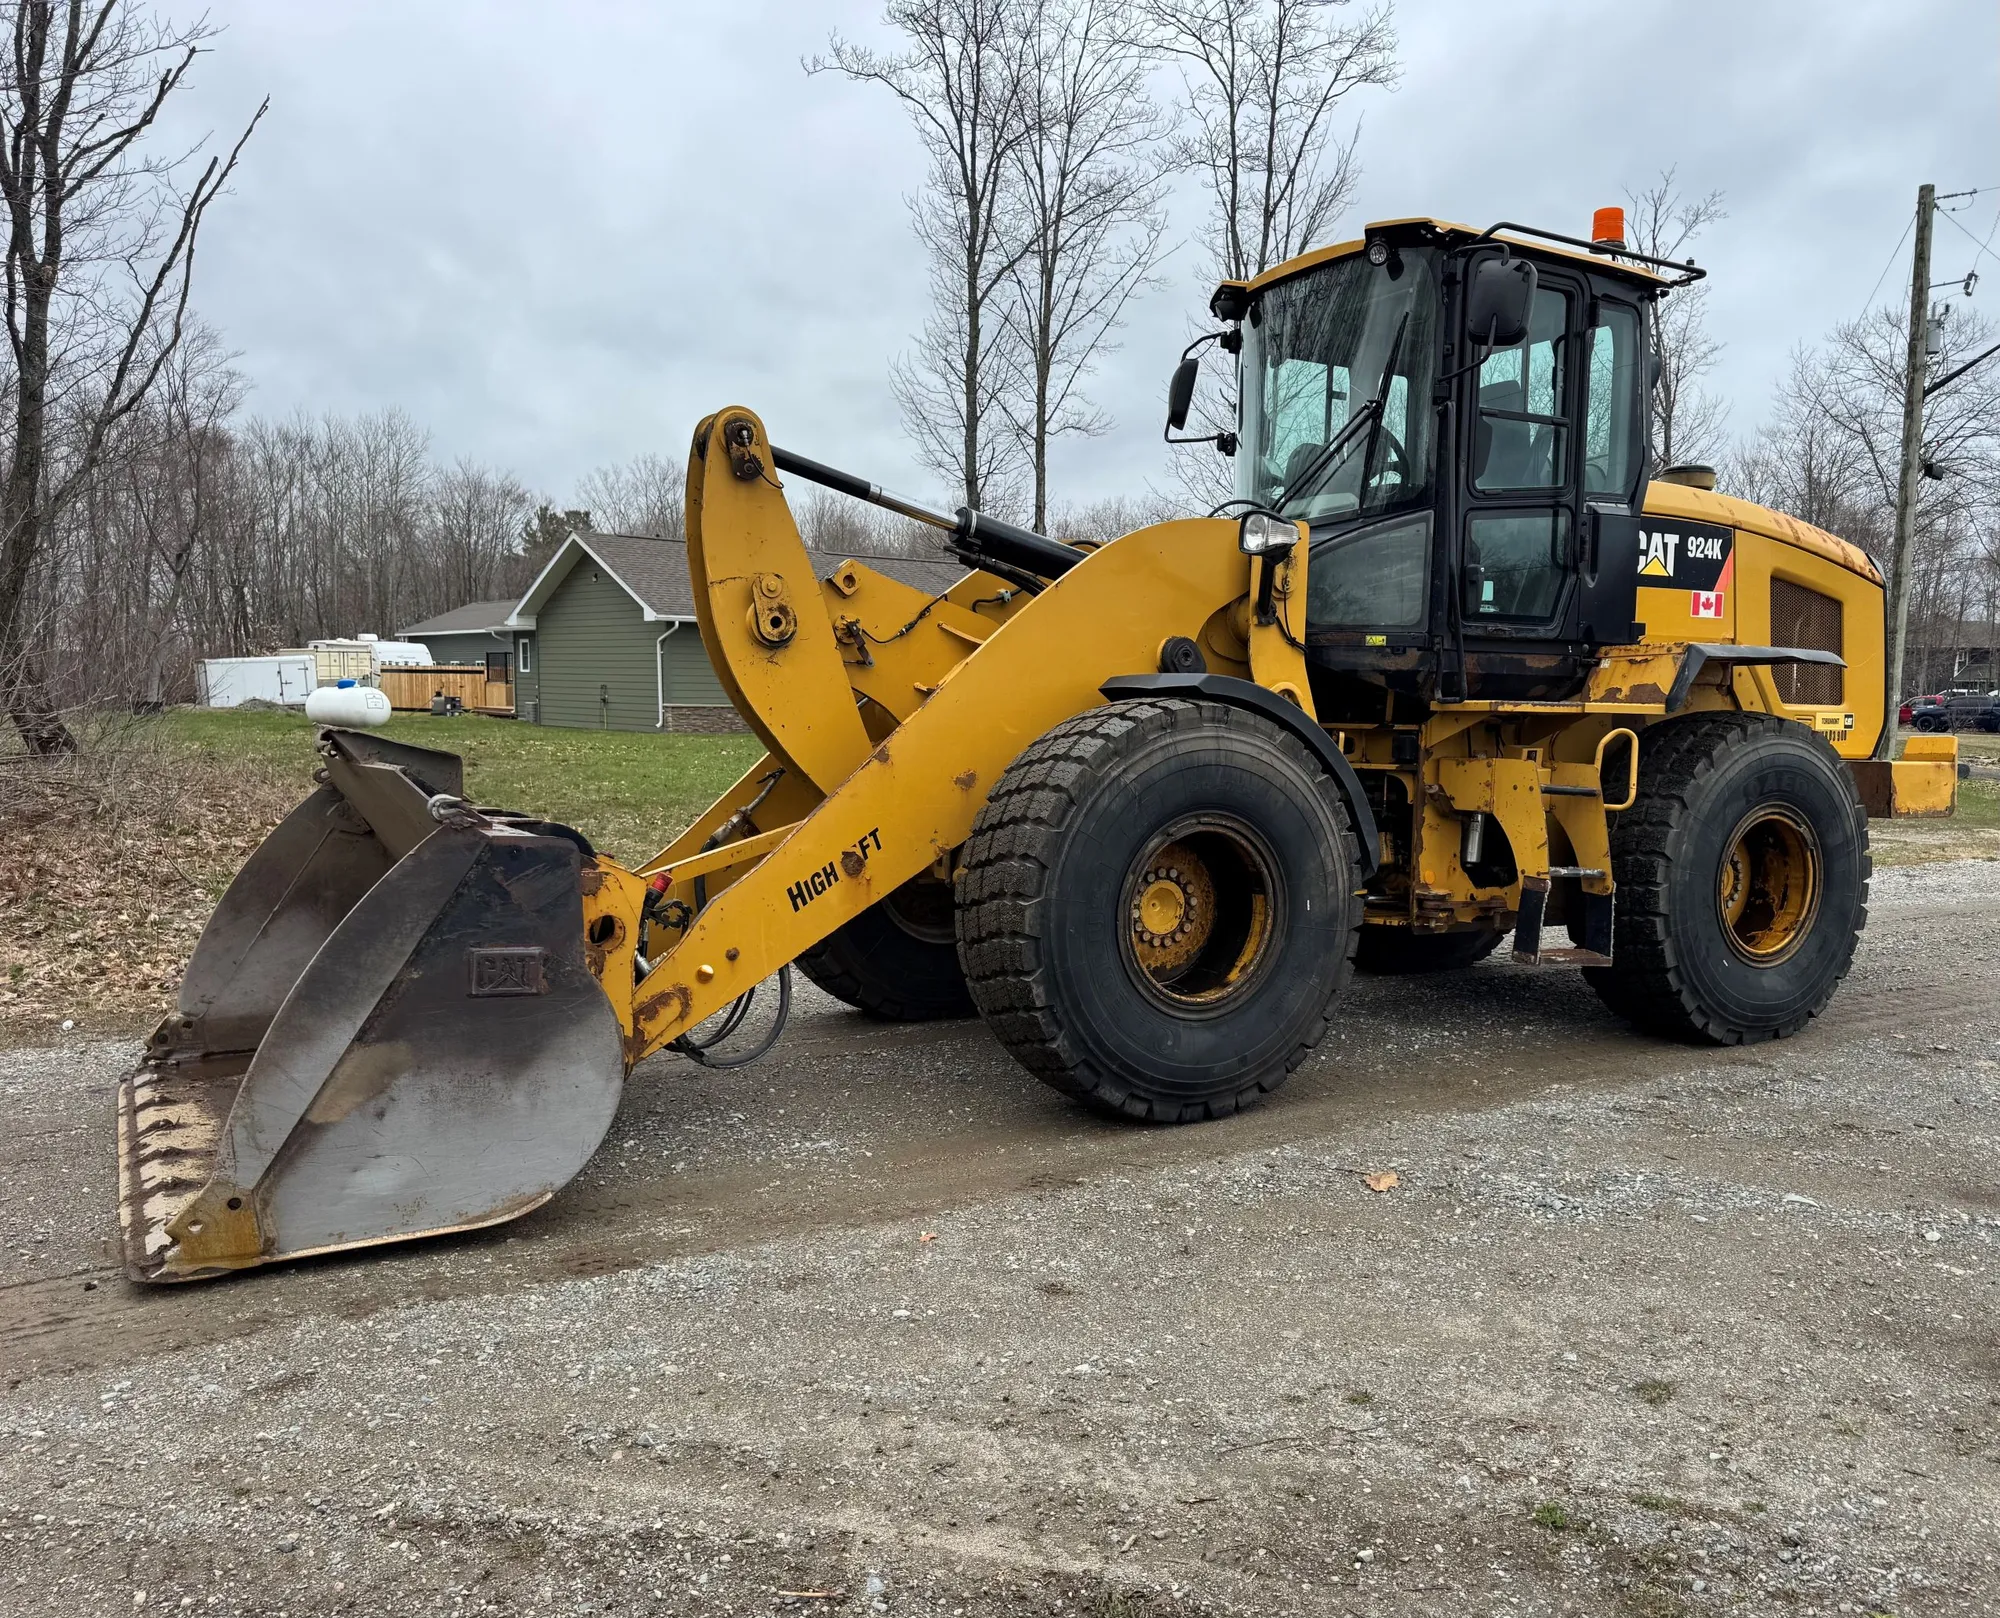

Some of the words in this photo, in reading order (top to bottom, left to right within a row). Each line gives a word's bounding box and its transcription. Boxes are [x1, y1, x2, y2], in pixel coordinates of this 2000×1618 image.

[1687, 536, 1723, 560] 924K
[786, 861, 840, 913] HIGH
[851, 827, 882, 861] FT
